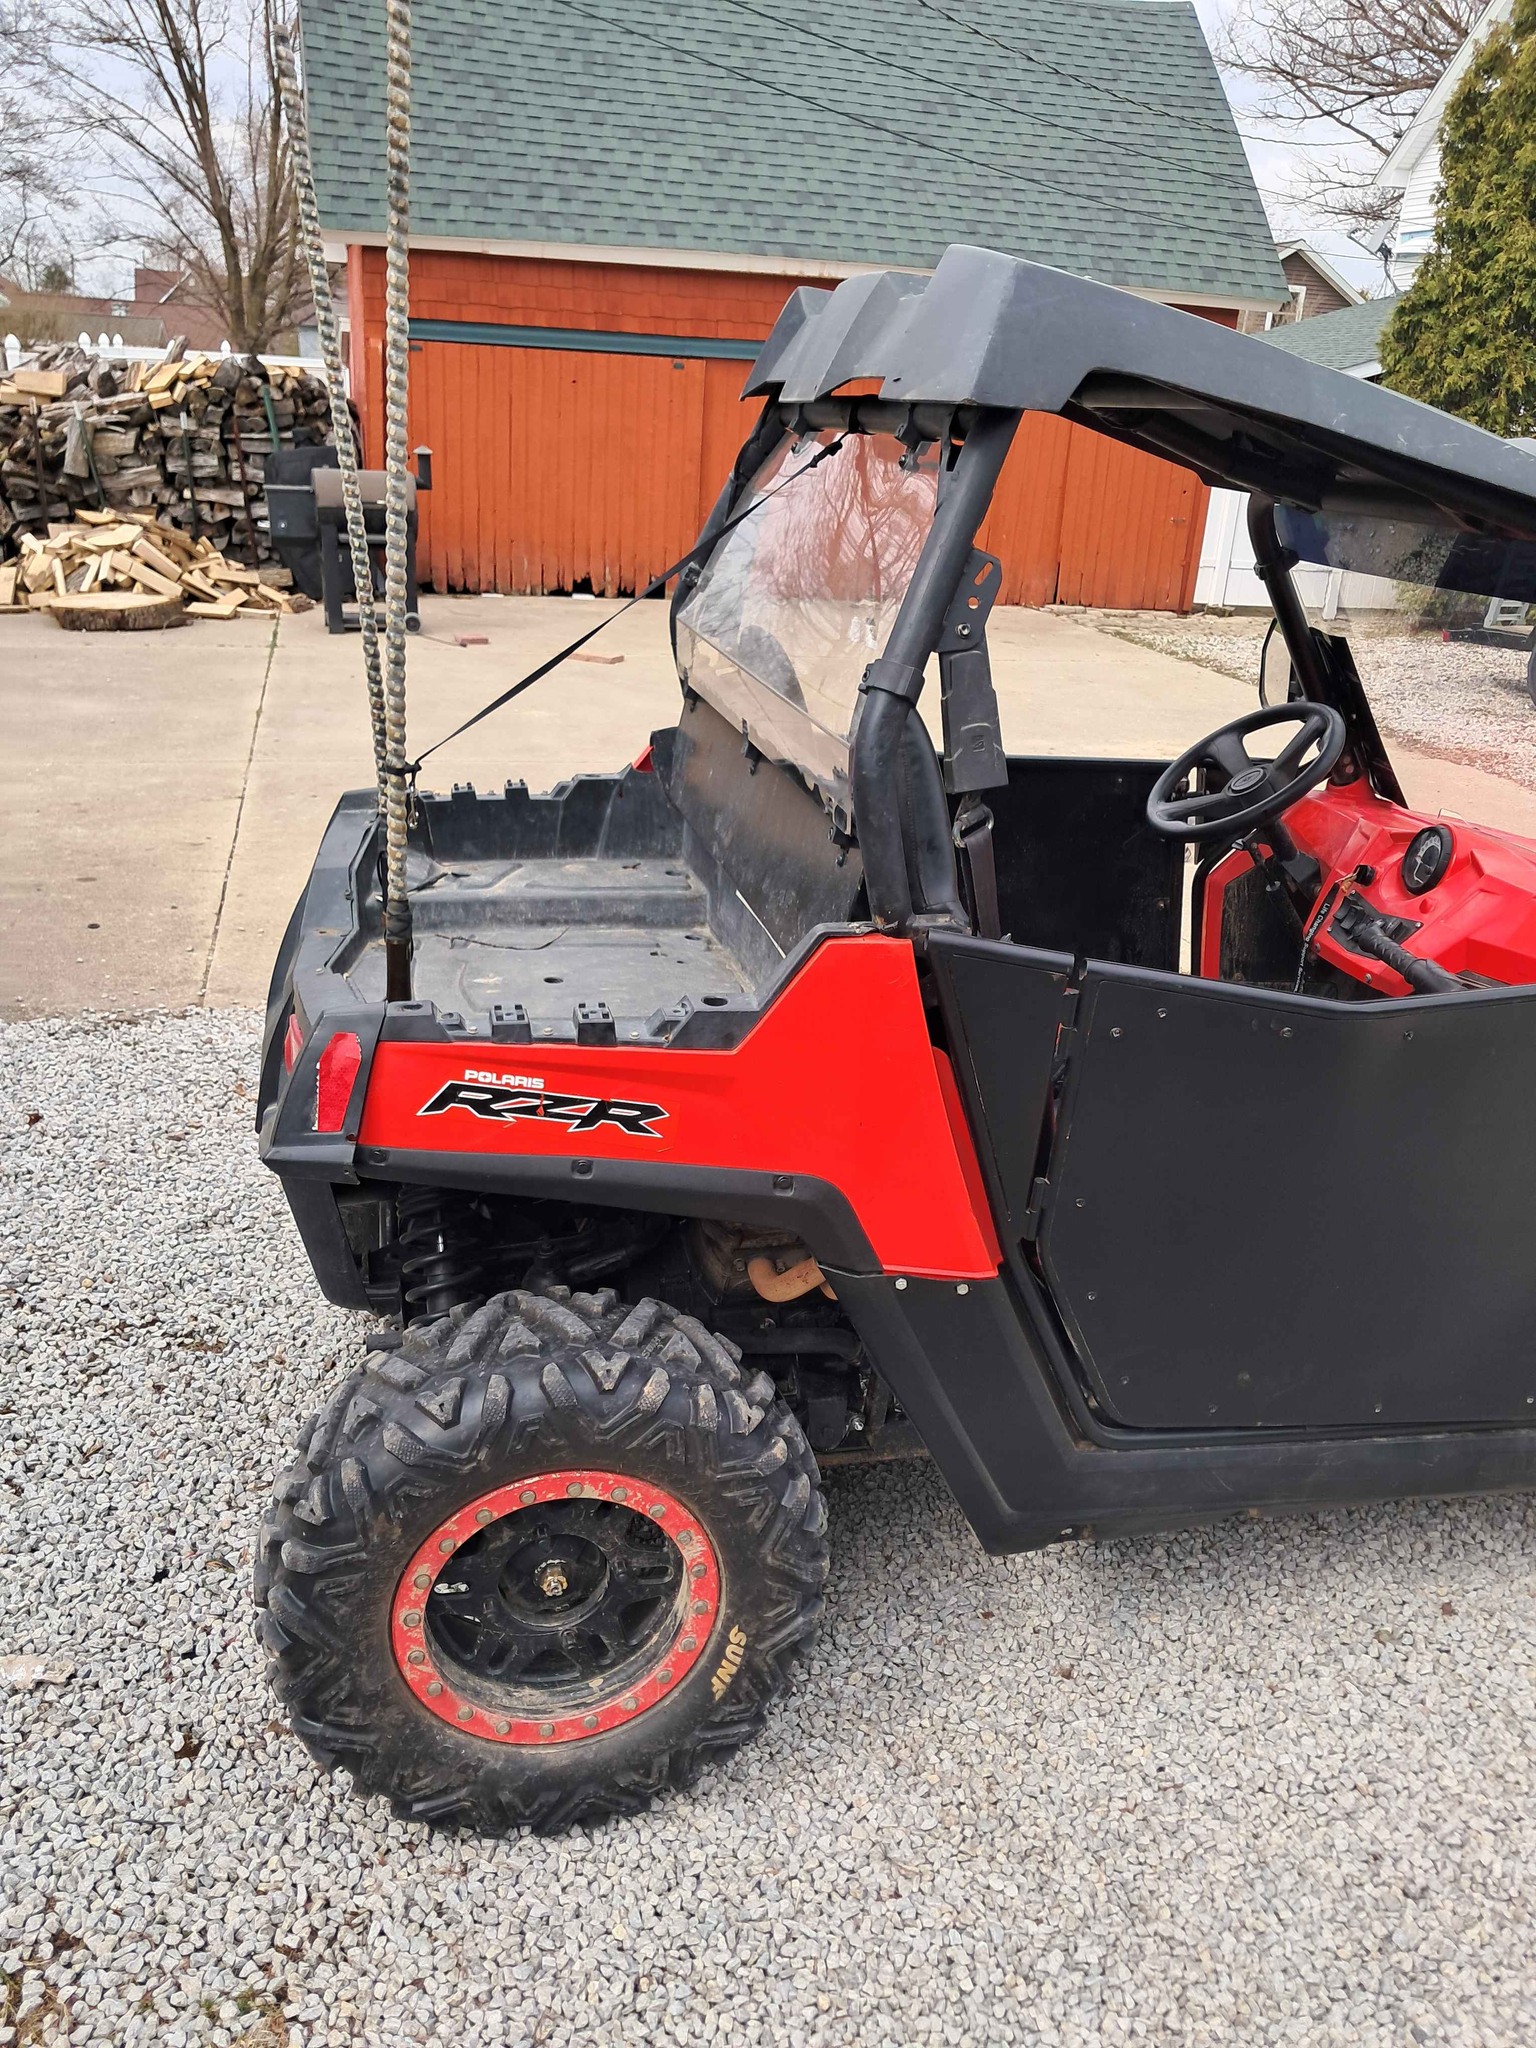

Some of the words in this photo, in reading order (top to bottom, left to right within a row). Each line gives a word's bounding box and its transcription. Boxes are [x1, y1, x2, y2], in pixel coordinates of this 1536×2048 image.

[1305, 914, 1324, 942] Changing
[464, 1069, 545, 1090] POLARIS
[416, 1080, 671, 1139] RZR
[710, 1624, 748, 1702] SUNF
